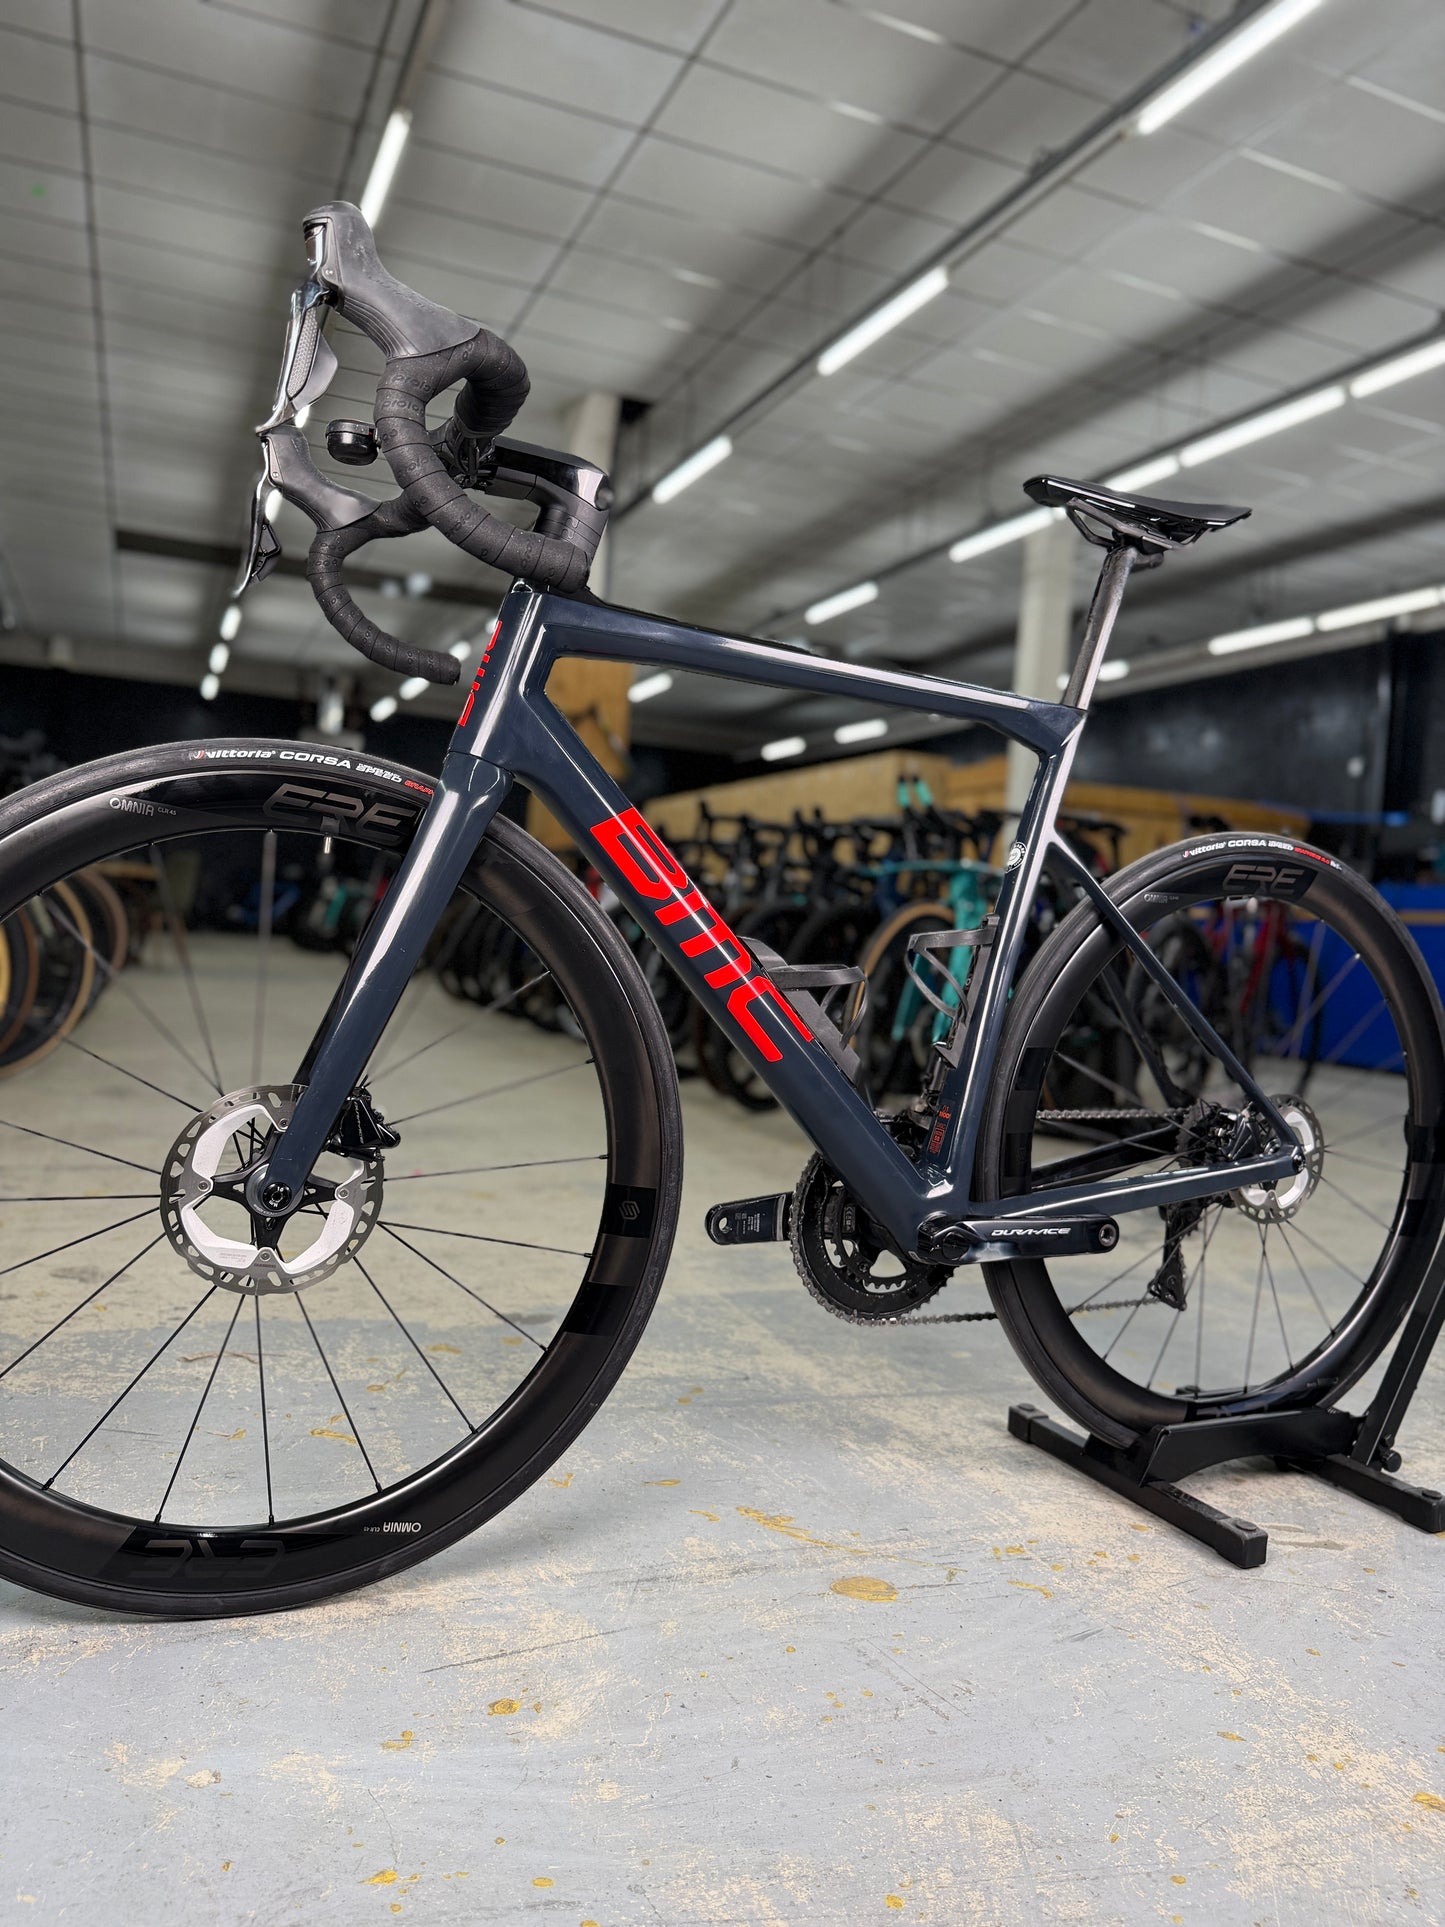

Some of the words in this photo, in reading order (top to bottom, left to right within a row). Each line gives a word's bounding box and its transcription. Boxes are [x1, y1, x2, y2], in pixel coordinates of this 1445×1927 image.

[205, 749, 274, 760] vittoria
[279, 751, 350, 769] CORSA
[109, 797, 155, 817] OMNIA
[263, 783, 417, 846] ERE
[1228, 839, 1267, 848] CORSA
[1222, 864, 1304, 894] ERE
[991, 1227, 1072, 1237] DURA-ACE
[383, 1521, 422, 1533] OMNIA
